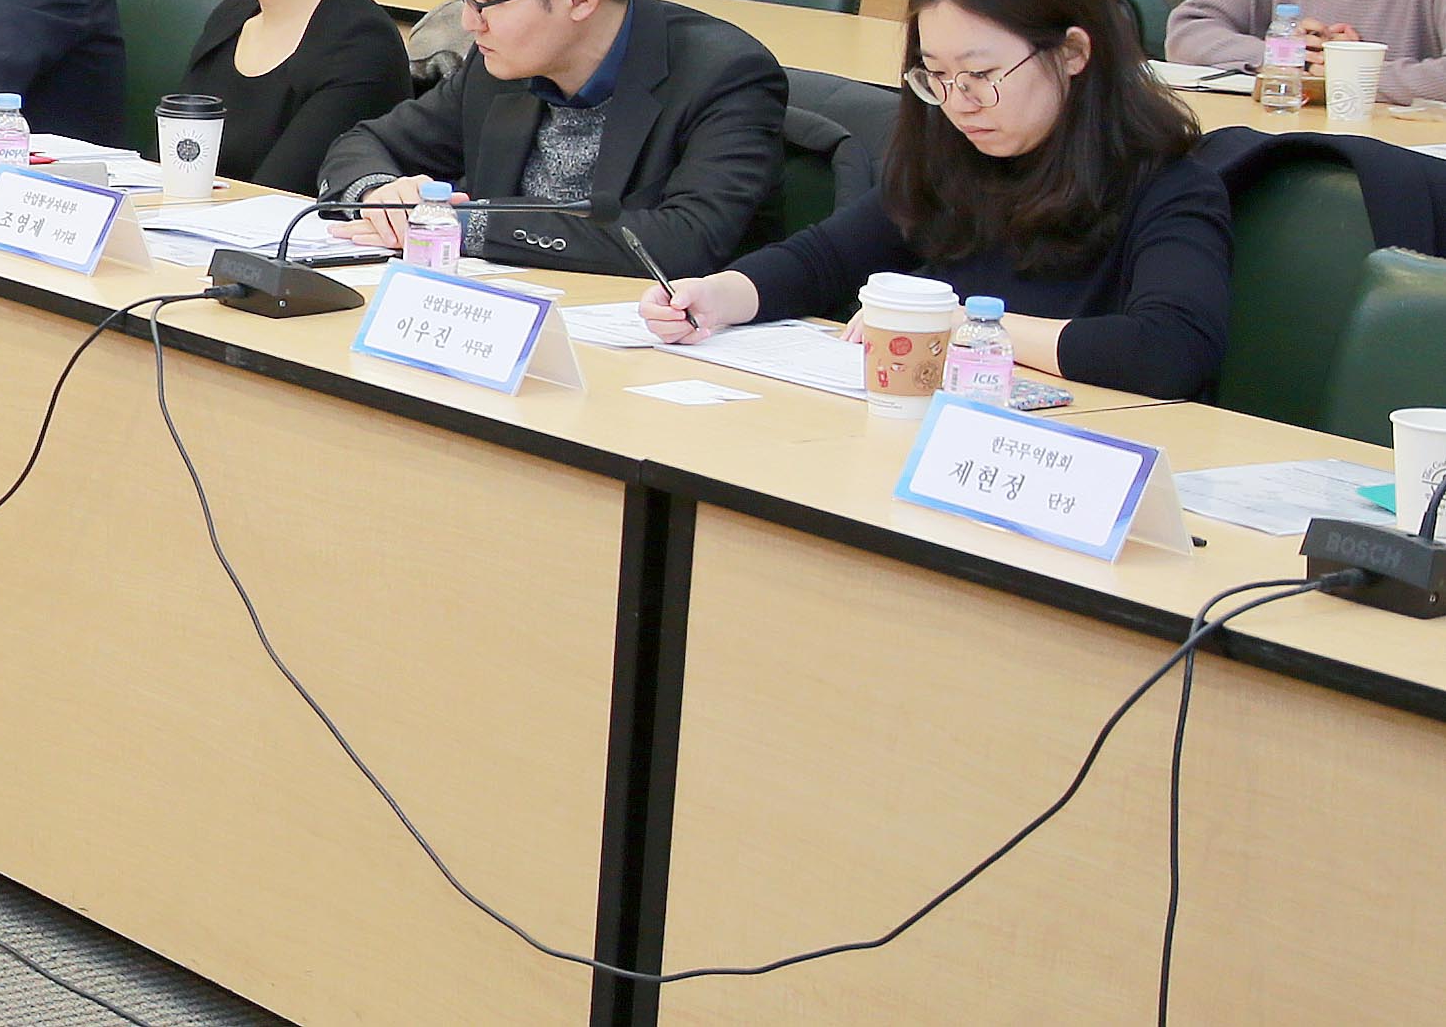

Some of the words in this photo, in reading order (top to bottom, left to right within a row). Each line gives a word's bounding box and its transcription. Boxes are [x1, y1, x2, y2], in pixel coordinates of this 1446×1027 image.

[50, 227, 78, 246] 서기관
[422, 293, 494, 325] 산업통상자원부
[396, 316, 454, 349] 이우진
[459, 338, 494, 359] 사무관
[990, 435, 1074, 474] 한국무역협회
[947, 459, 1026, 501] 제현정
[1047, 492, 1076, 515] 단장
[1324, 530, 1403, 569] BOSCH
